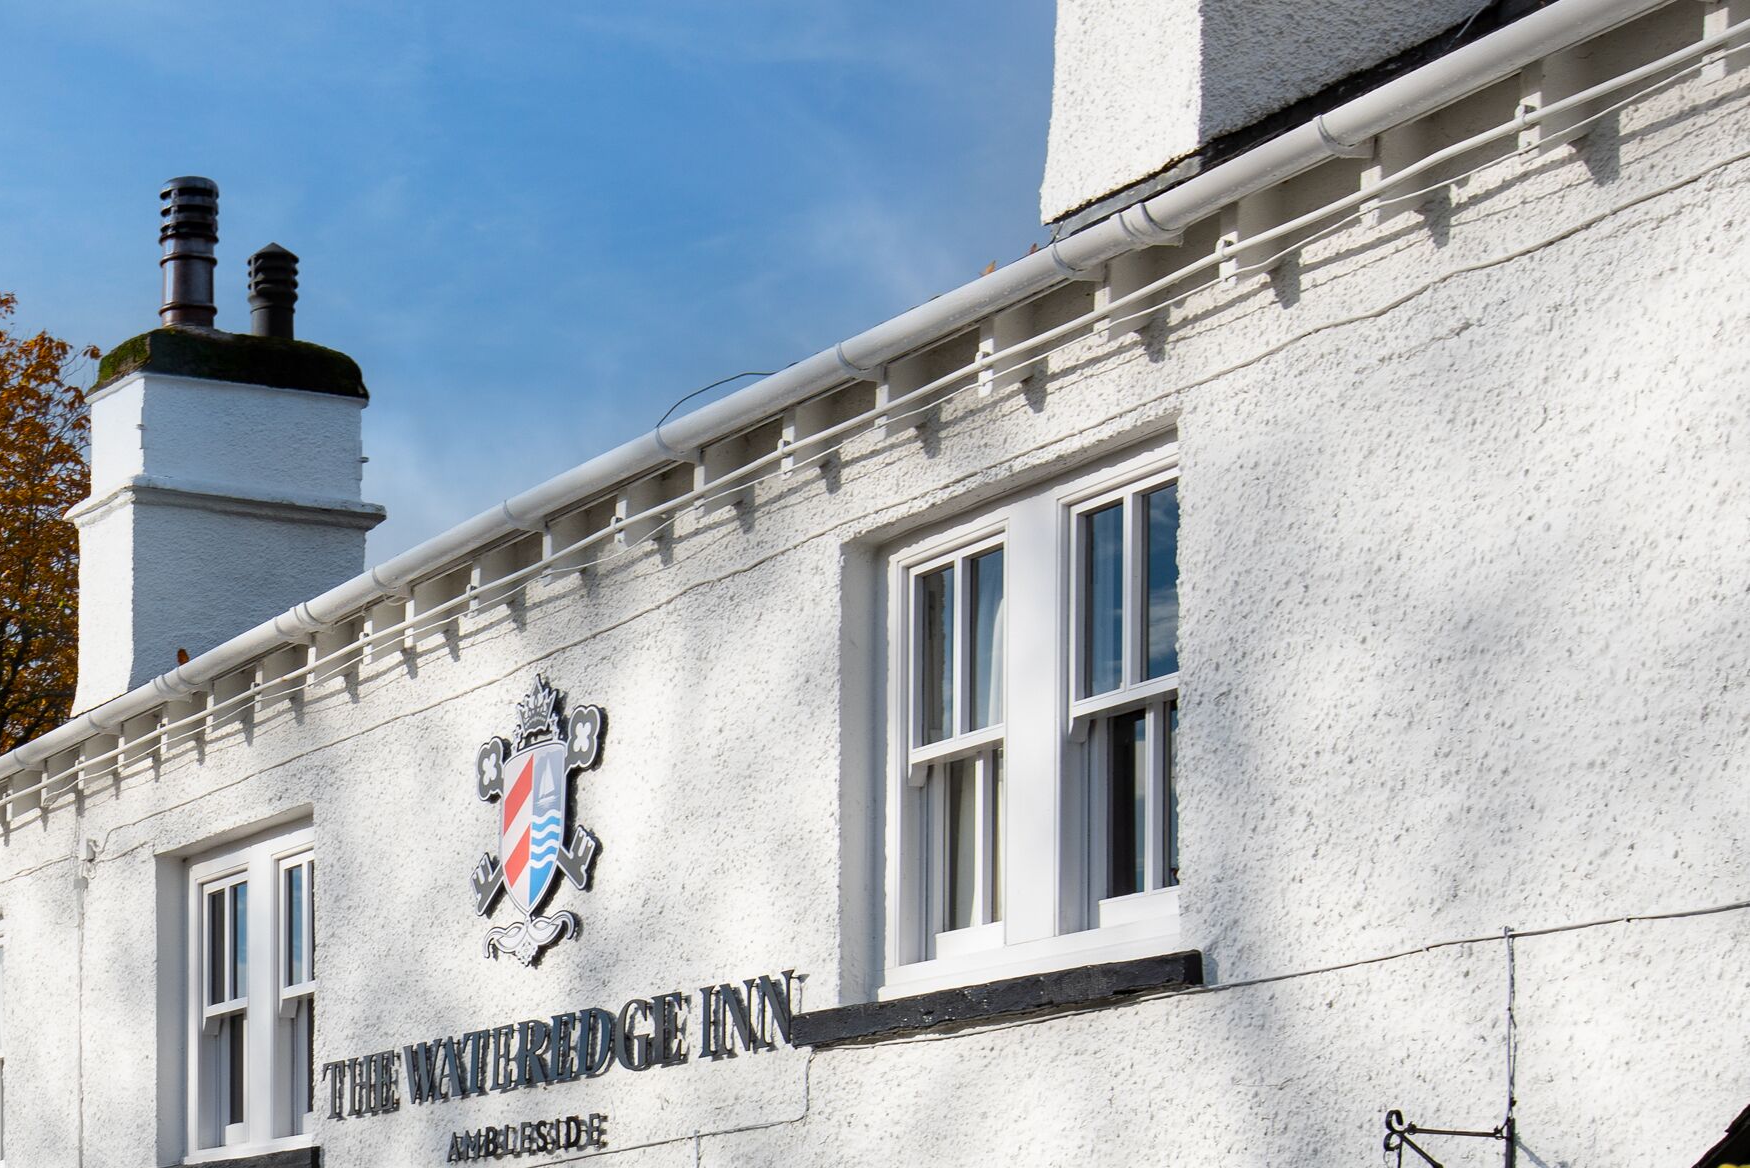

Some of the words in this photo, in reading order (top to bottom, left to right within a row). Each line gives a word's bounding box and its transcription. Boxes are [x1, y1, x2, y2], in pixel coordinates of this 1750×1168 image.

[323, 1050, 396, 1120] THE
[403, 991, 683, 1105] WATEREDGE
[699, 968, 796, 1060] INN
[447, 1112, 602, 1163] AMBLESIDE
